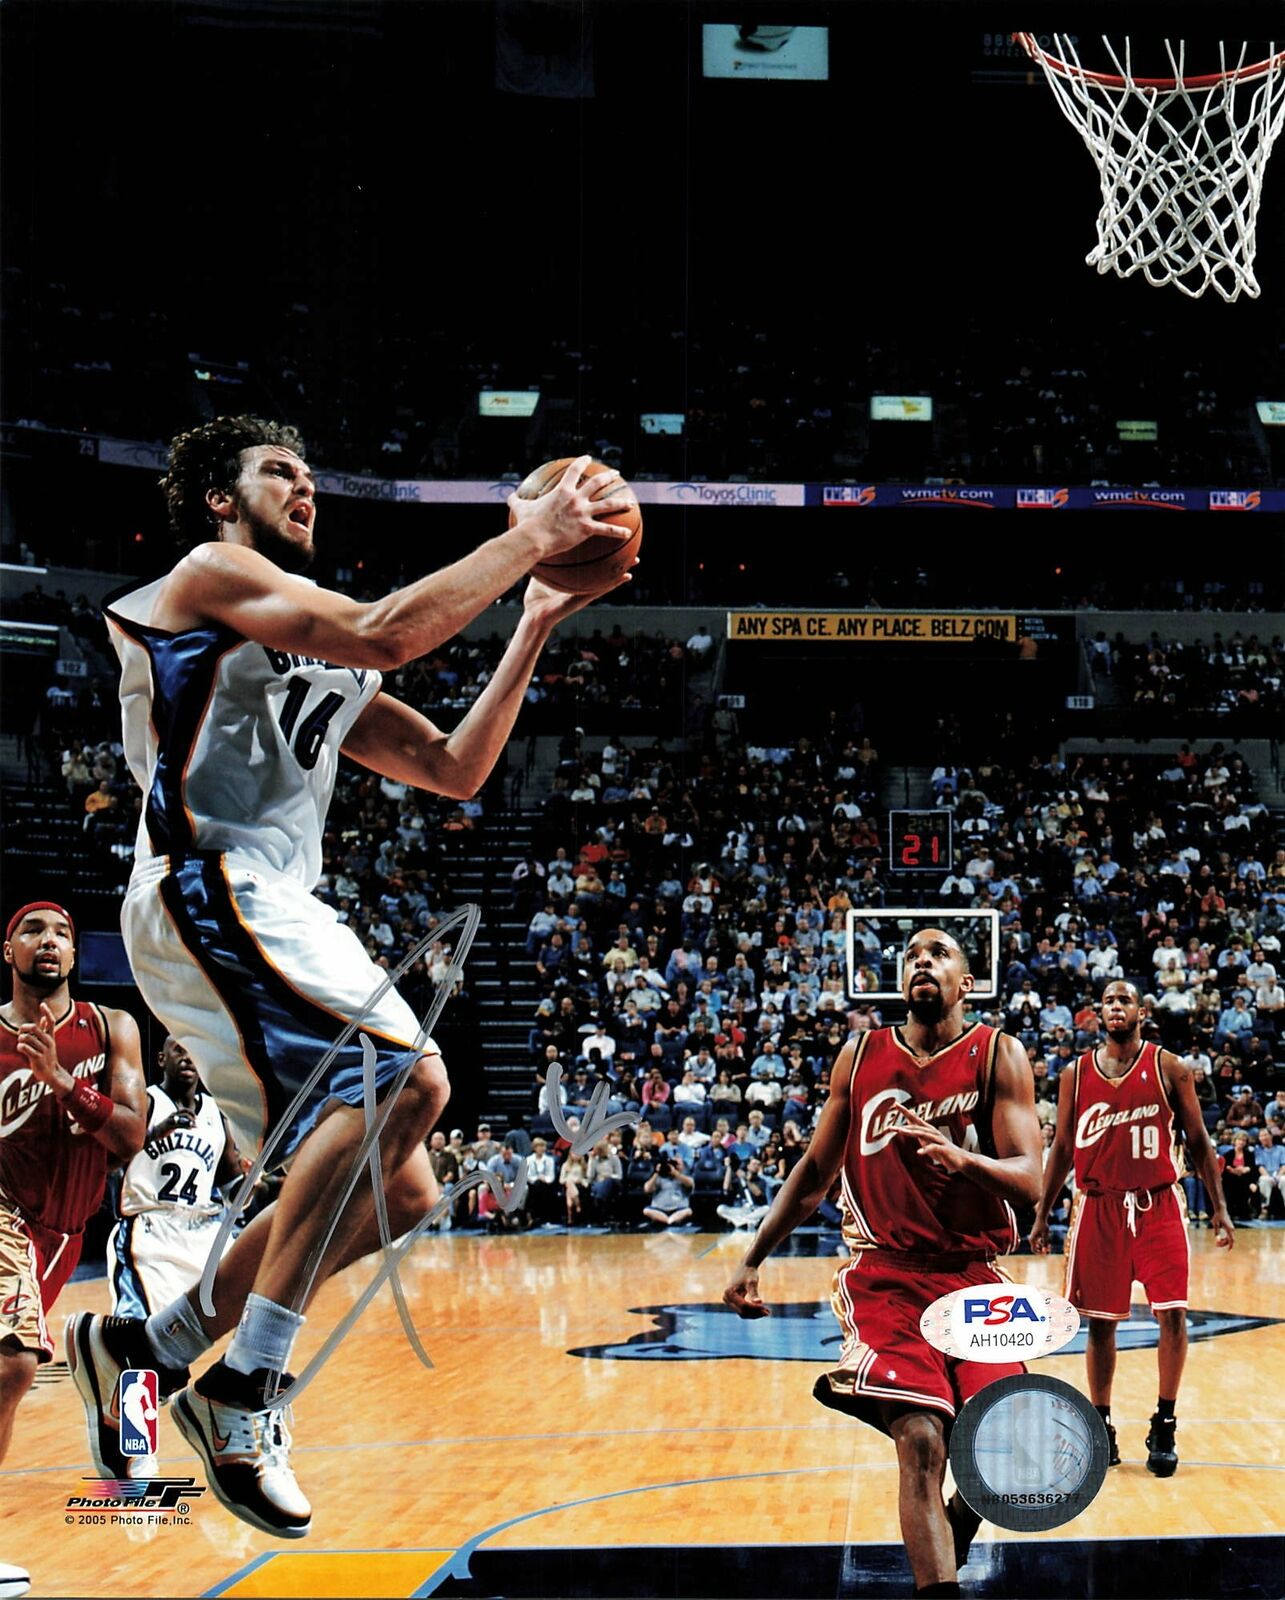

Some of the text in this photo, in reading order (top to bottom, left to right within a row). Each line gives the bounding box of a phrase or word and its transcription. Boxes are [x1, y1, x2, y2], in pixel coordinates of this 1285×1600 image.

[902, 488, 993, 499] wmctv.com
[1095, 490, 1185, 501] wmctv.com
[737, 617, 768, 635] ANY
[836, 618, 867, 636] ANY
[872, 618, 925, 637] PLACE.
[931, 618, 1009, 638] BELZ.COM
[278, 674, 346, 770] 16
[902, 834, 940, 865] 21
[0, 1053, 106, 1138] CLEVAND
[1075, 1101, 1160, 1149] CLEVELAND
[1129, 1124, 1160, 1160] 19
[158, 1162, 199, 1206] 24
[964, 1295, 1040, 1326] PSA
[970, 1333, 1034, 1348] AH10420
